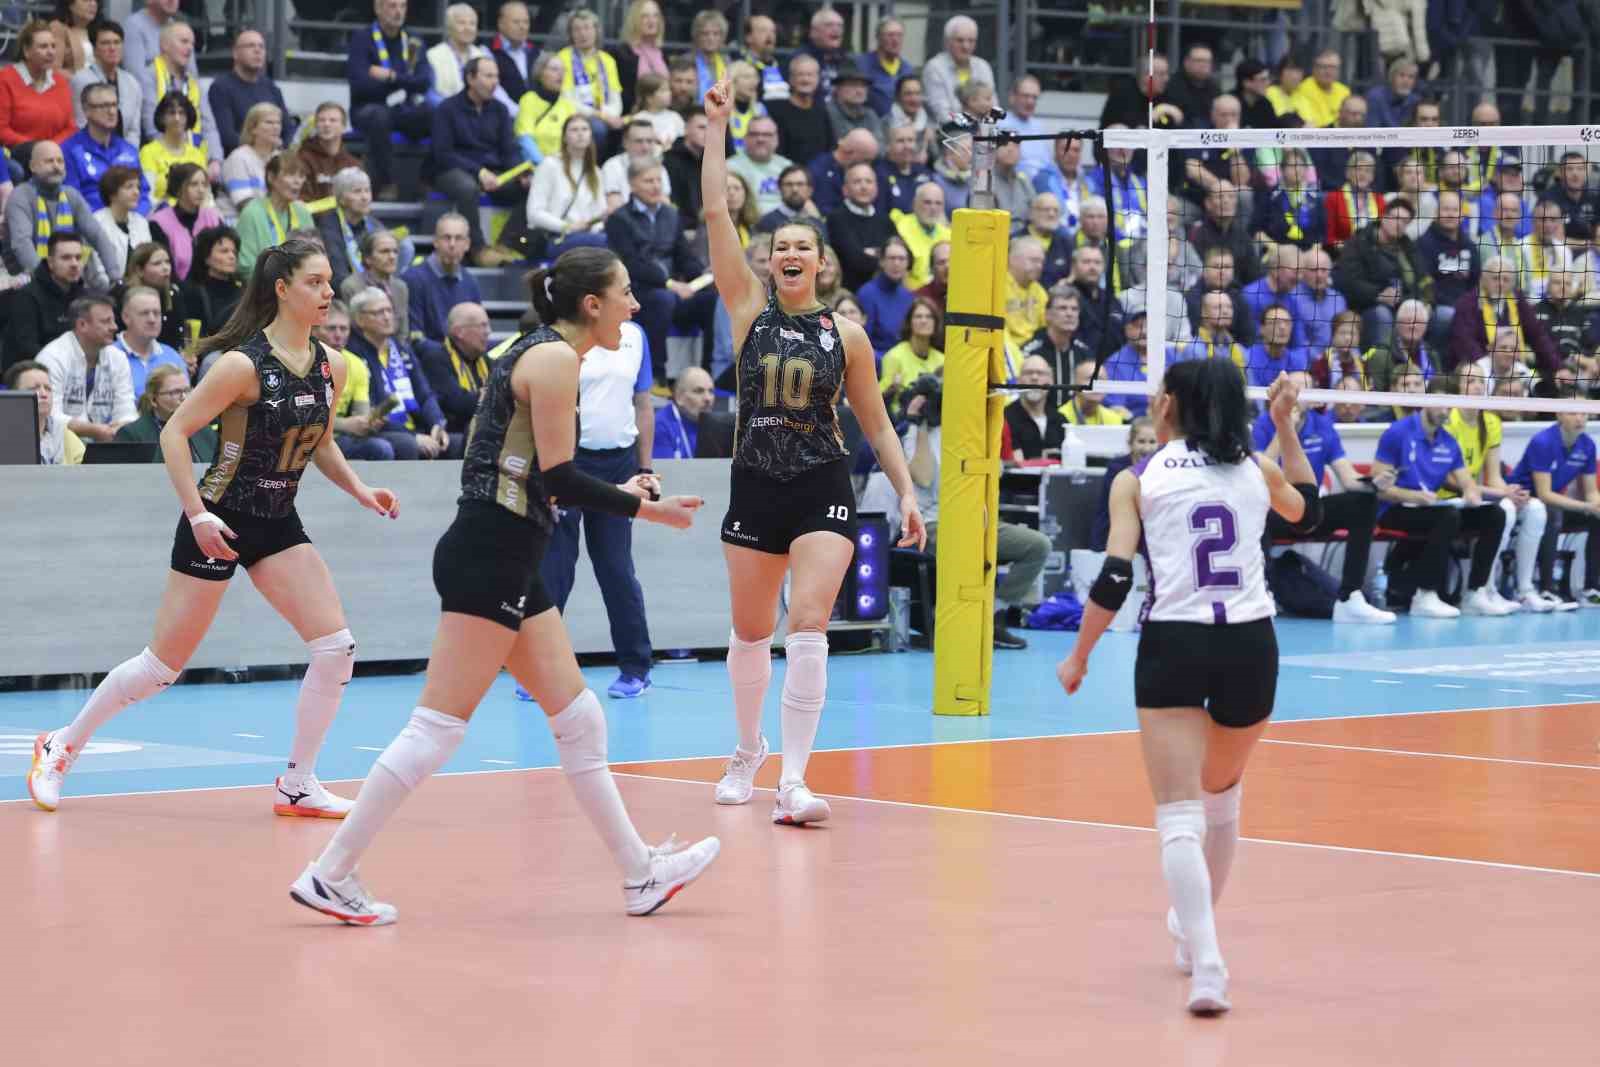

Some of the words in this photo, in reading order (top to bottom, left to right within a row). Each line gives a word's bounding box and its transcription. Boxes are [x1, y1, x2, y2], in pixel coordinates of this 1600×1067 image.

[1452, 128, 1479, 138] ZEREN
[759, 352, 815, 411] 10
[752, 416, 783, 428] ZEREN
[276, 423, 327, 473] 12
[257, 478, 288, 489] ZEREN
[825, 504, 849, 521] 10
[1187, 501, 1243, 592] 2
